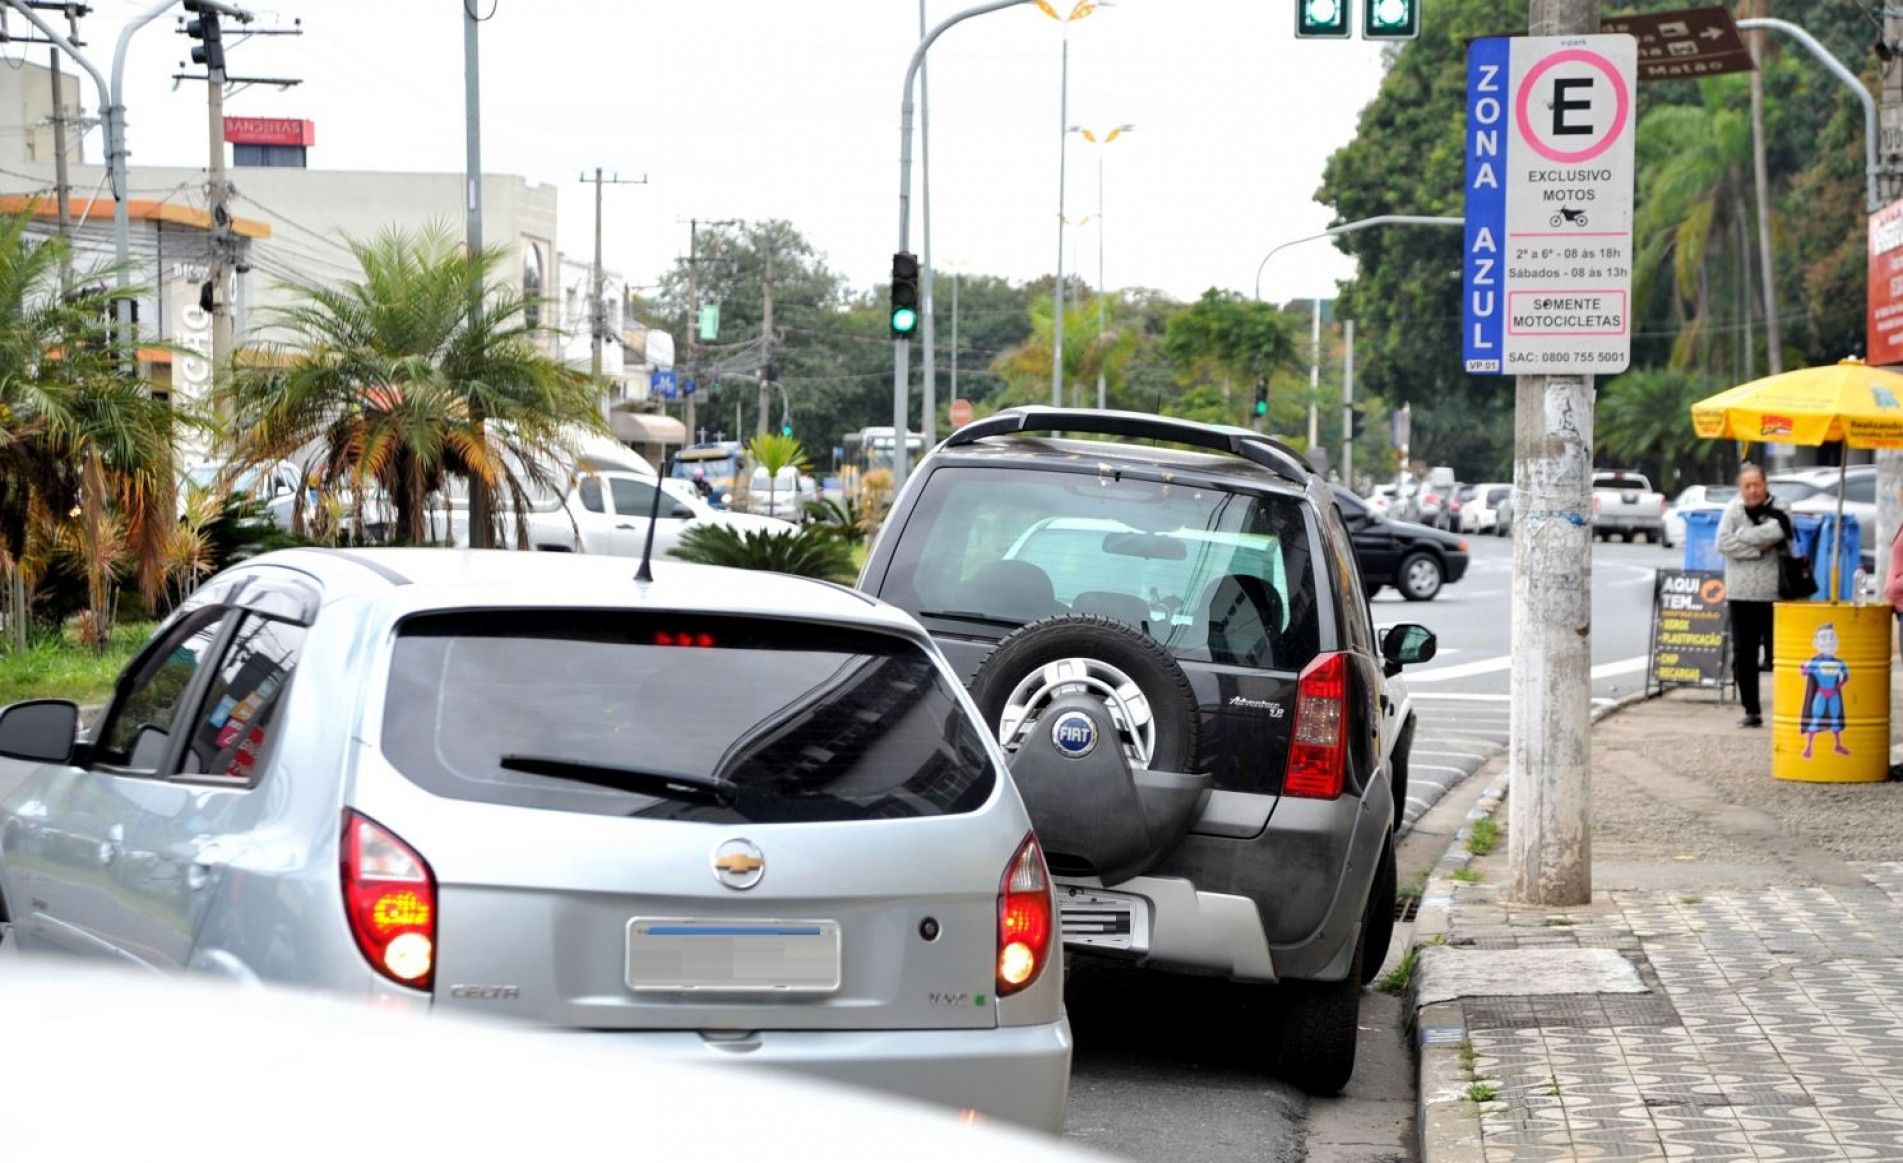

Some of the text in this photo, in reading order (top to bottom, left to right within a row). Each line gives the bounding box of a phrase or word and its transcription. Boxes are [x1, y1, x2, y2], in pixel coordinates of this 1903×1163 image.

[1552, 78, 1594, 135] E
[1528, 169, 1612, 182] EXCLUSIVO
[1543, 189, 1596, 201] MOTOS
[1472, 64, 1500, 349] ZONA AZUL
[1531, 250, 1538, 259] a
[1564, 248, 1578, 259] 08
[1600, 248, 1621, 259] 18h
[1509, 268, 1560, 278] Sábados
[1571, 267, 1585, 278] 08
[1588, 267, 1602, 278] às
[1607, 267, 1627, 277] 13h
[1533, 298, 1601, 310] SOMENTE
[1513, 315, 1621, 327] MOTOCICLETAS
[1509, 352, 1625, 363] SAC: 0800 755 5001
[1661, 577, 1700, 593] AQUI
[1060, 726, 1090, 742] FIAT
[450, 983, 519, 1000] CELTA
